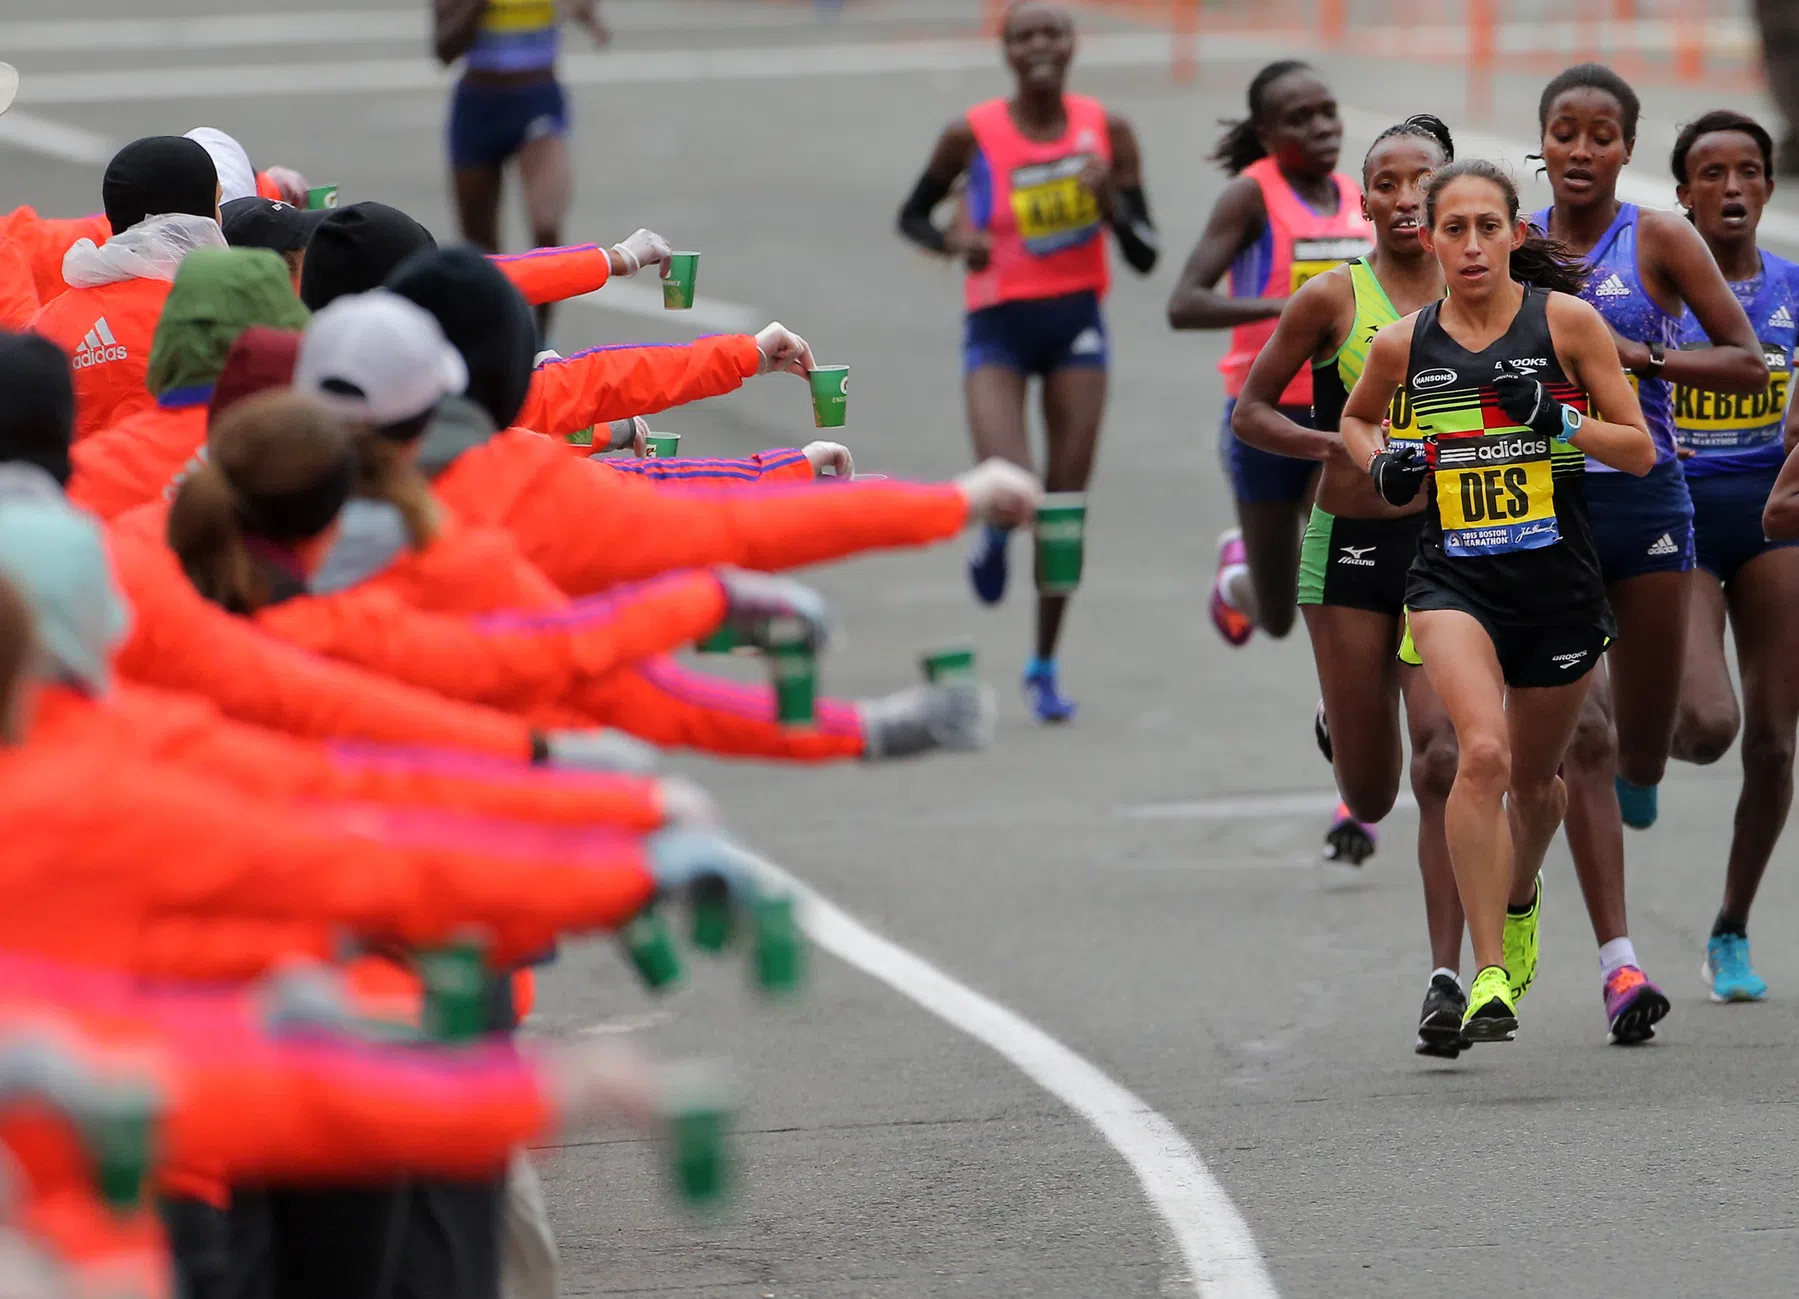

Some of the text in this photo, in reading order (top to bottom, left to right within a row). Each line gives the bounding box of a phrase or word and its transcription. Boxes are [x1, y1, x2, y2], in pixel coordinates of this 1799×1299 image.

[1595, 287, 1631, 296] adidas
[72, 344, 128, 369] adidas
[1494, 358, 1548, 369] BOOKS
[1416, 372, 1453, 385] HANSONS
[1478, 439, 1547, 460] adidas
[1459, 467, 1528, 522] DES
[1462, 529, 1507, 540] 2015 BOSTON
[1463, 537, 1509, 547] MARATHON
[1552, 649, 1588, 661] BROOKS
